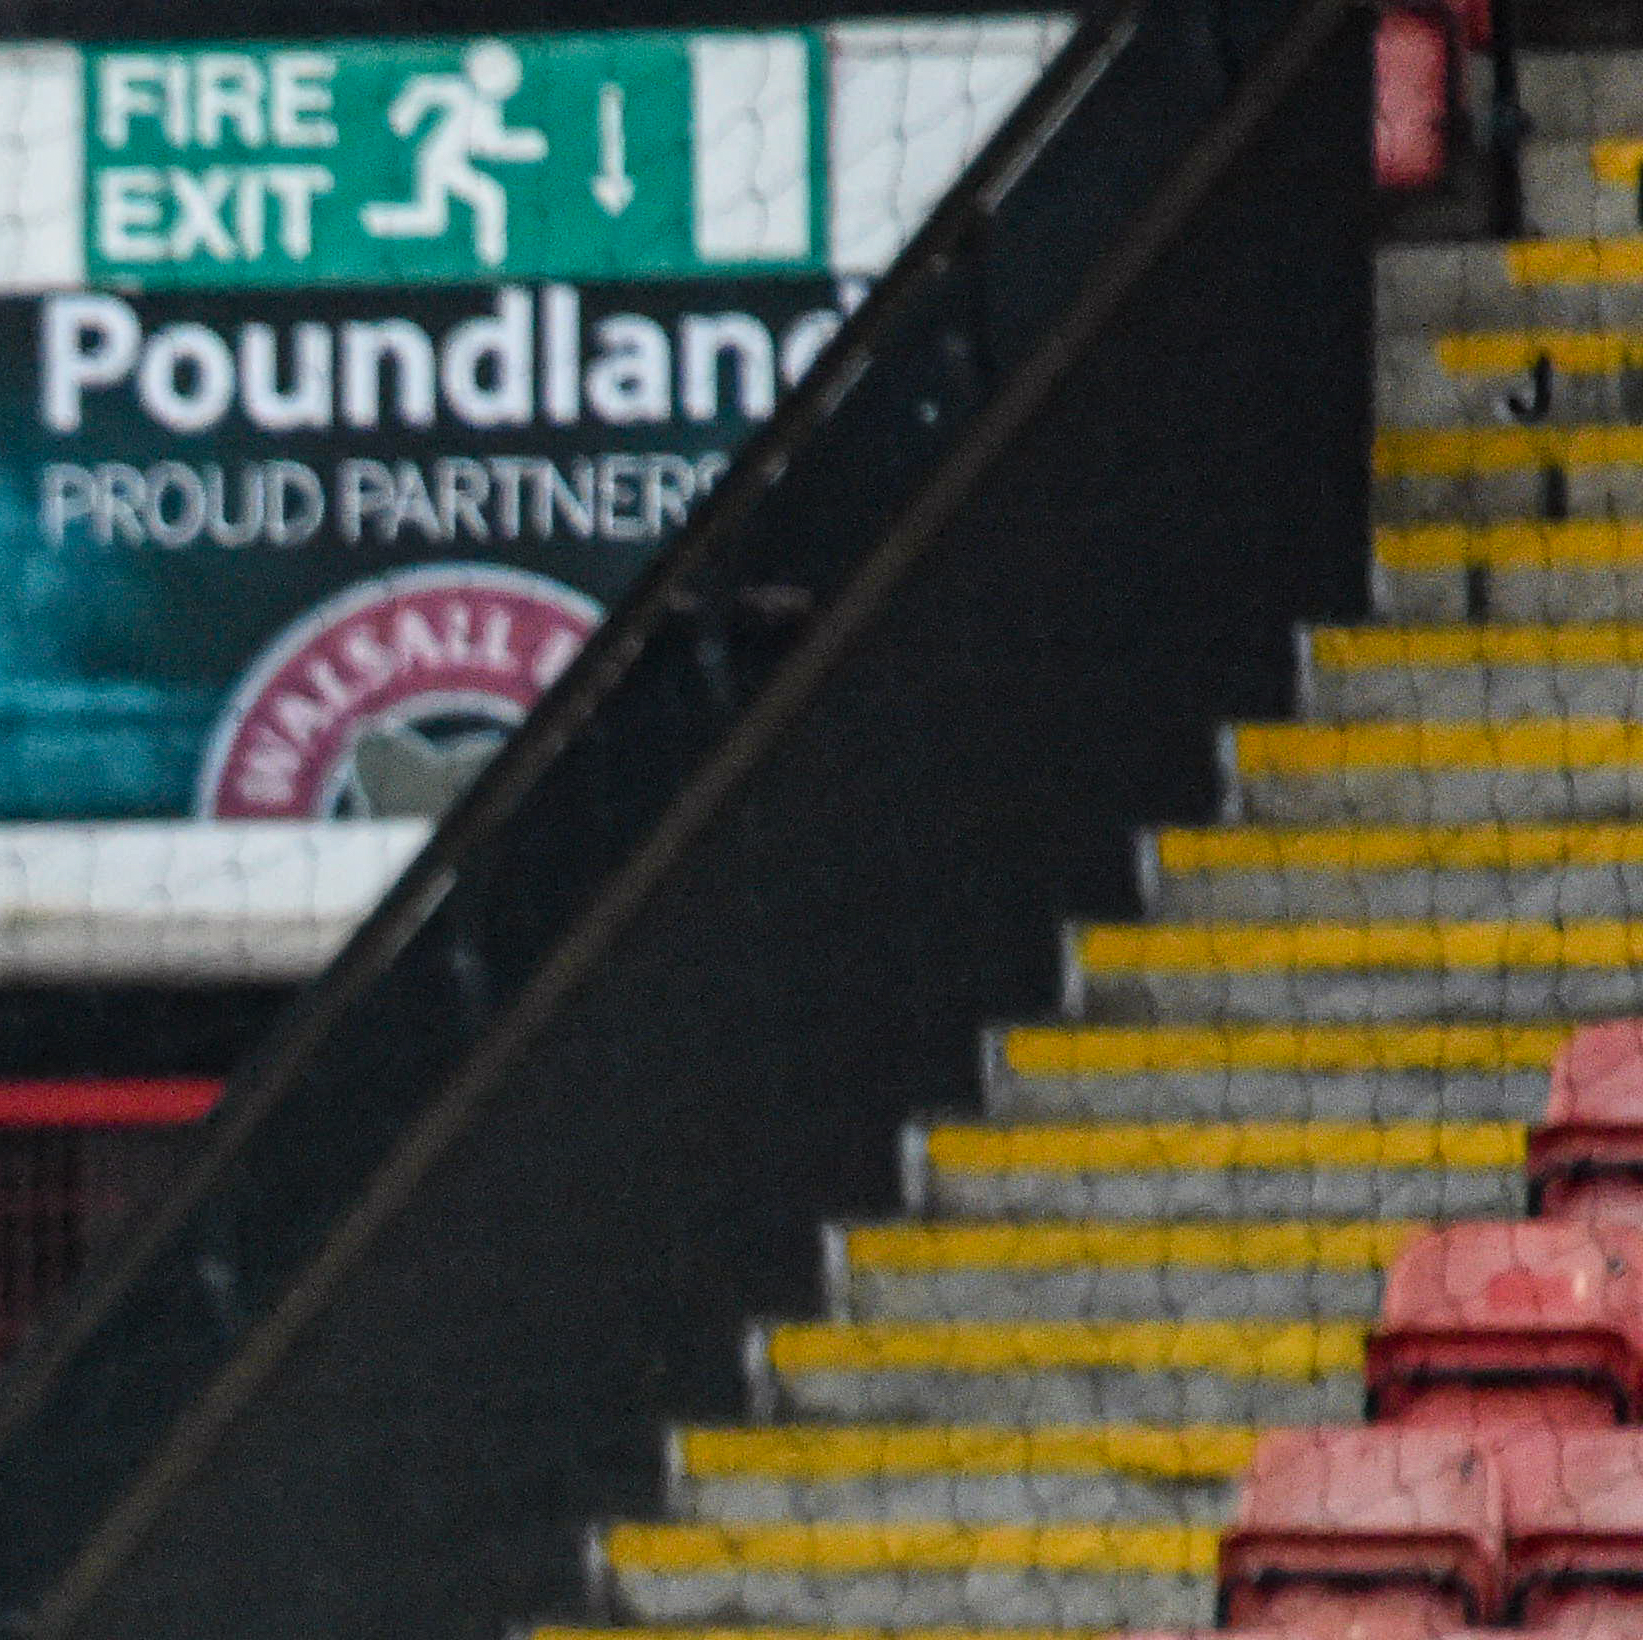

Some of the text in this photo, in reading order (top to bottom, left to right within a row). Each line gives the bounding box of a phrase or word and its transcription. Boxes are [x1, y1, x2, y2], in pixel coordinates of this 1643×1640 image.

[98, 52, 339, 149] FIRE
[98, 163, 335, 263] EXIT
[40, 462, 325, 549] PROUD
[237, 602, 513, 802] WALSALL
